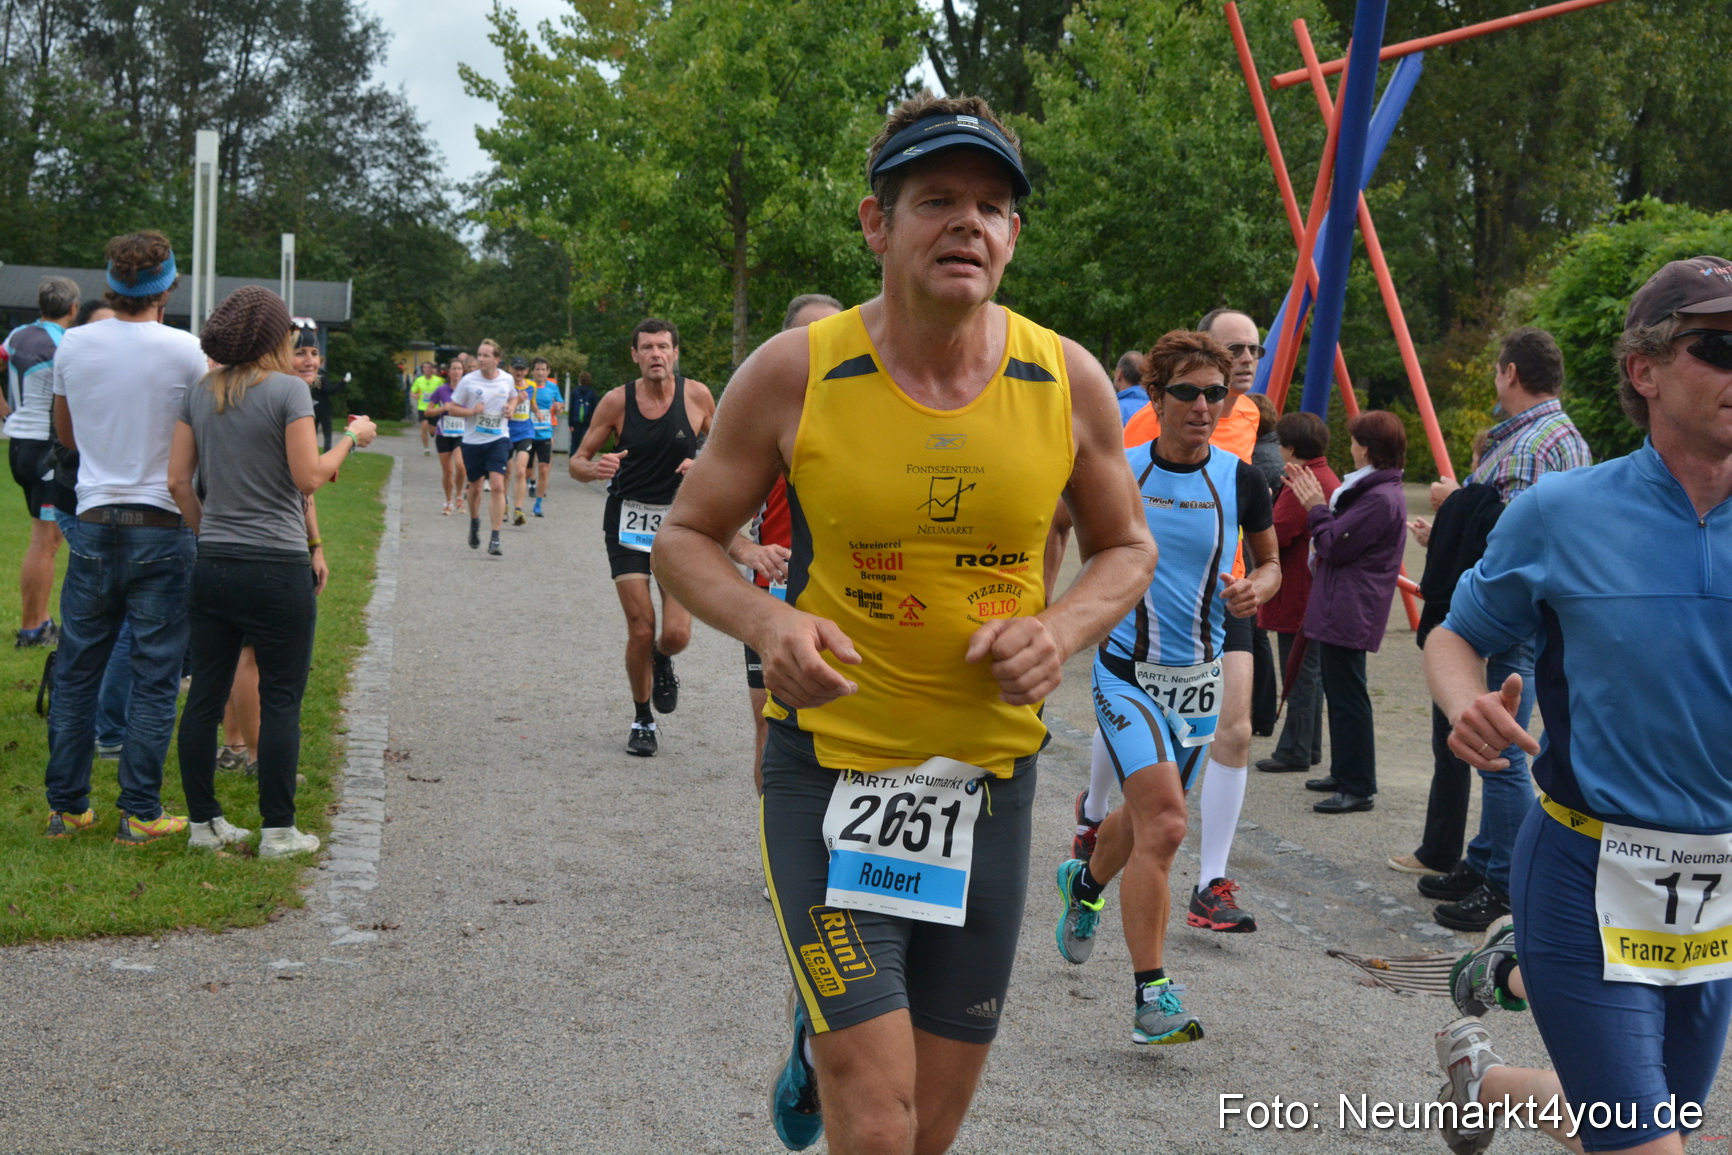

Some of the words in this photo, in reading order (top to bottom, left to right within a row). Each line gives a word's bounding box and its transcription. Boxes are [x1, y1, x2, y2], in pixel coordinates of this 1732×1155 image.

[906, 464, 985, 474] FONDSZENTRUM
[917, 524, 974, 535] NEUMARKT
[848, 539, 902, 550] Schreinerei
[852, 551, 904, 571] Seidl
[860, 570, 897, 582] Berngau
[966, 583, 1022, 605] PIZZERIA
[976, 598, 1017, 617] ELIO
[1137, 670, 1169, 683] PARTL
[1170, 671, 1209, 684] Neumarkt
[843, 768, 900, 789] PARTL
[903, 772, 964, 790] Neumarkt
[838, 792, 962, 858] 2651
[1605, 839, 1666, 863] PARTL
[858, 862, 921, 895] Robert
[1654, 872, 1722, 925] 17
[820, 911, 867, 972] Run!
[1619, 936, 1677, 964] Franz
[1682, 939, 1729, 964] Xaver
[810, 946, 840, 991] Team
